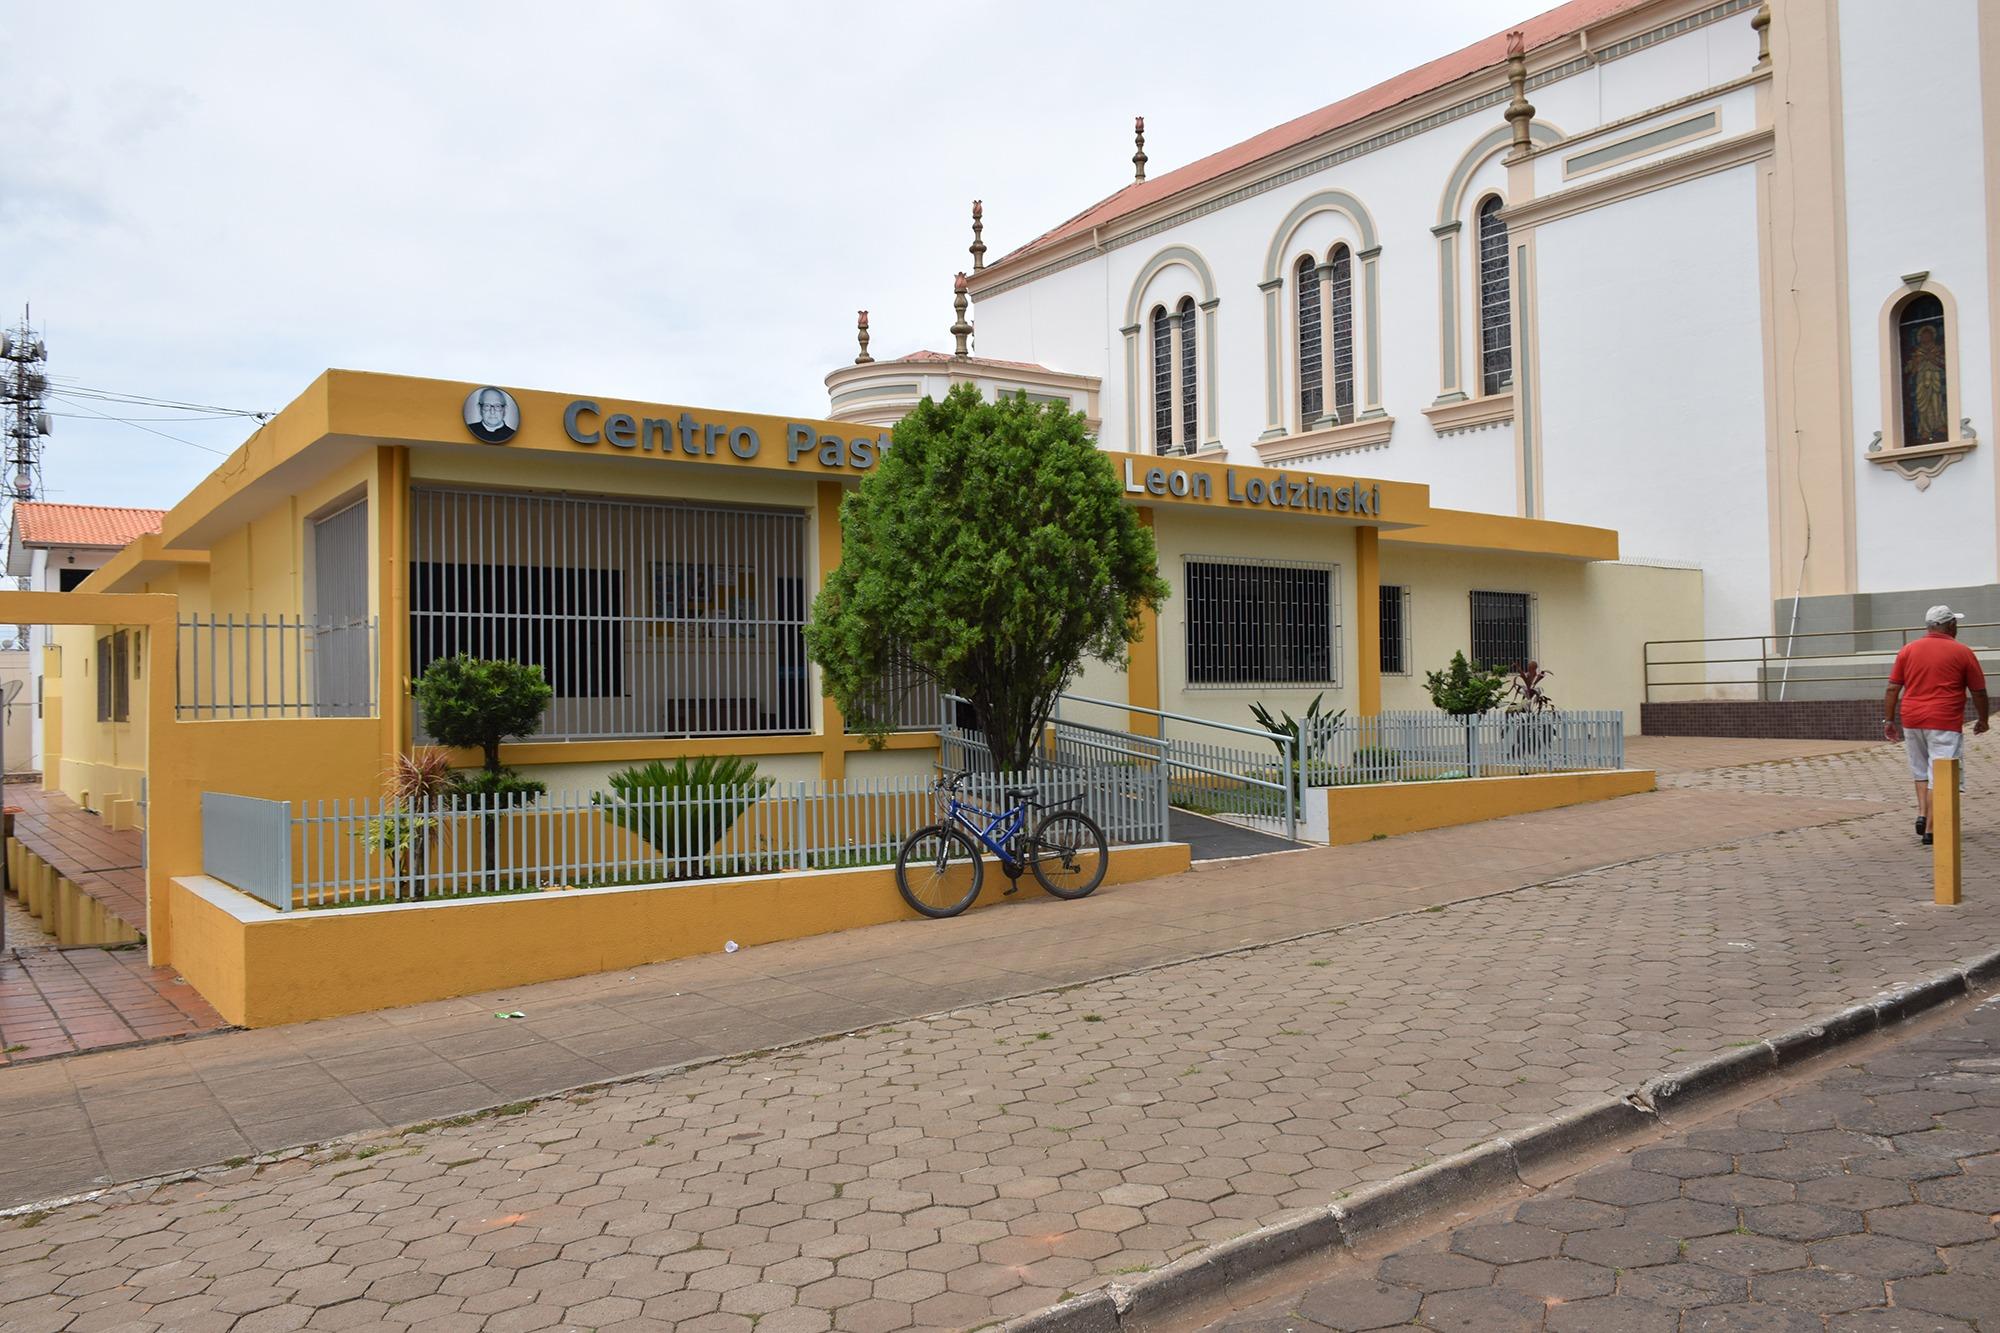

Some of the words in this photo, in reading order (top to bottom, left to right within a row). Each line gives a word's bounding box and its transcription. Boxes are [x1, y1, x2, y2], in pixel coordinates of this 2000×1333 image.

[564, 400, 760, 459] Centro
[787, 423, 894, 469] Past
[1124, 458, 1212, 498] Leon
[1228, 469, 1381, 514] Lodzinski
